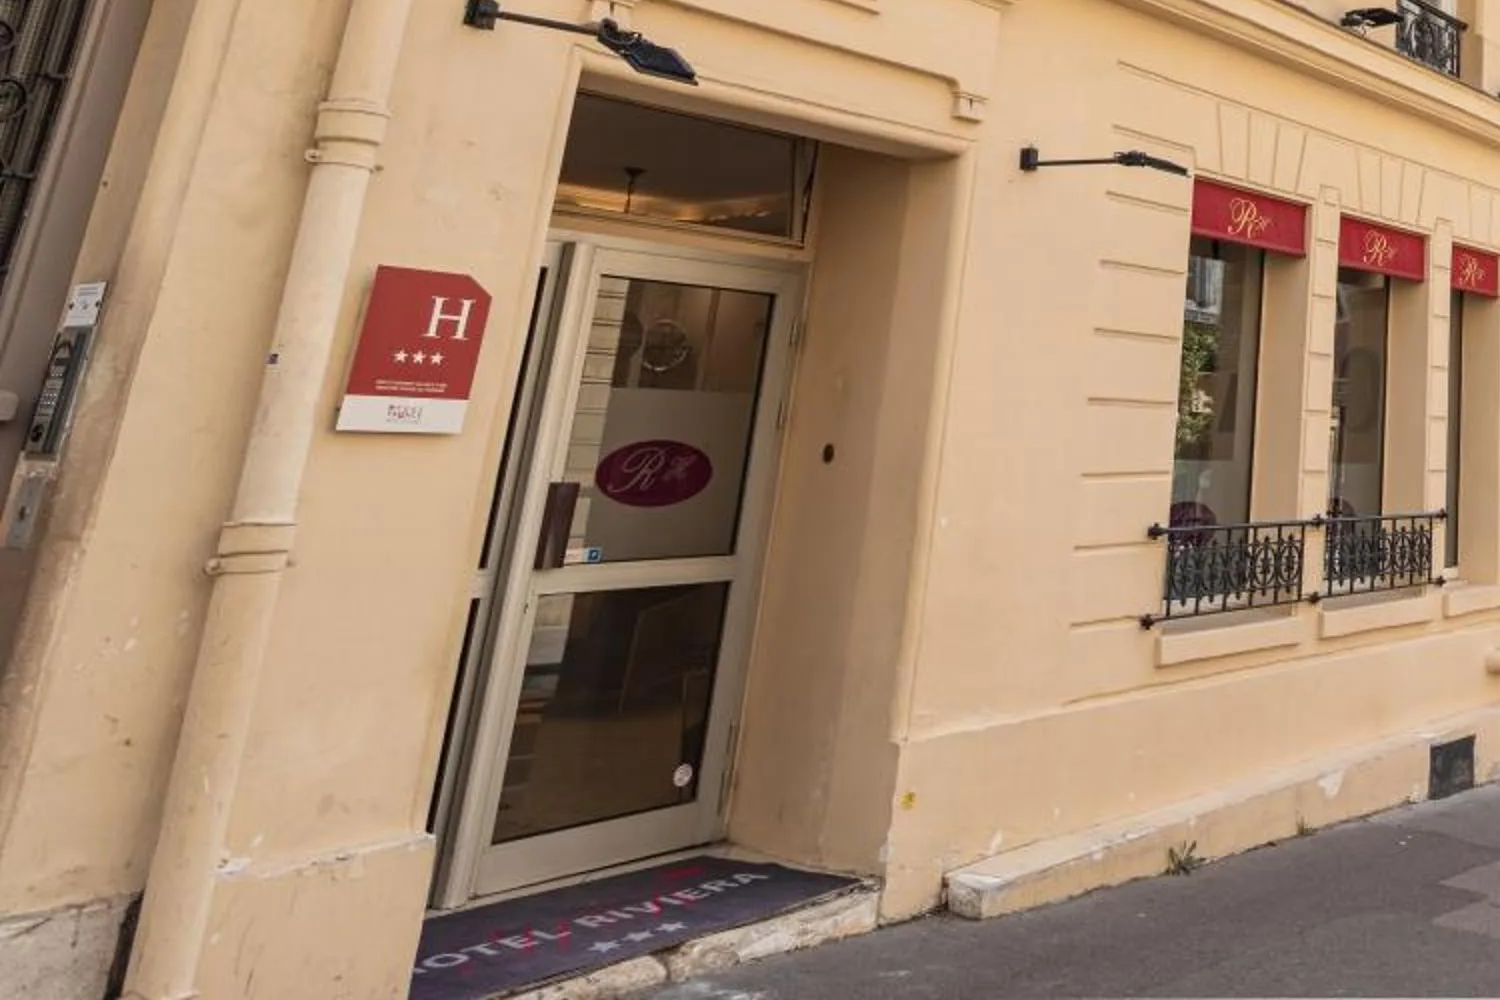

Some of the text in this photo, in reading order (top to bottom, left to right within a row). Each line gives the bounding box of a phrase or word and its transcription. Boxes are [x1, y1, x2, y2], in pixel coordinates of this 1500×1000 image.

[421, 295, 477, 341] H
[413, 872, 770, 975] OTEL RIVIERA
